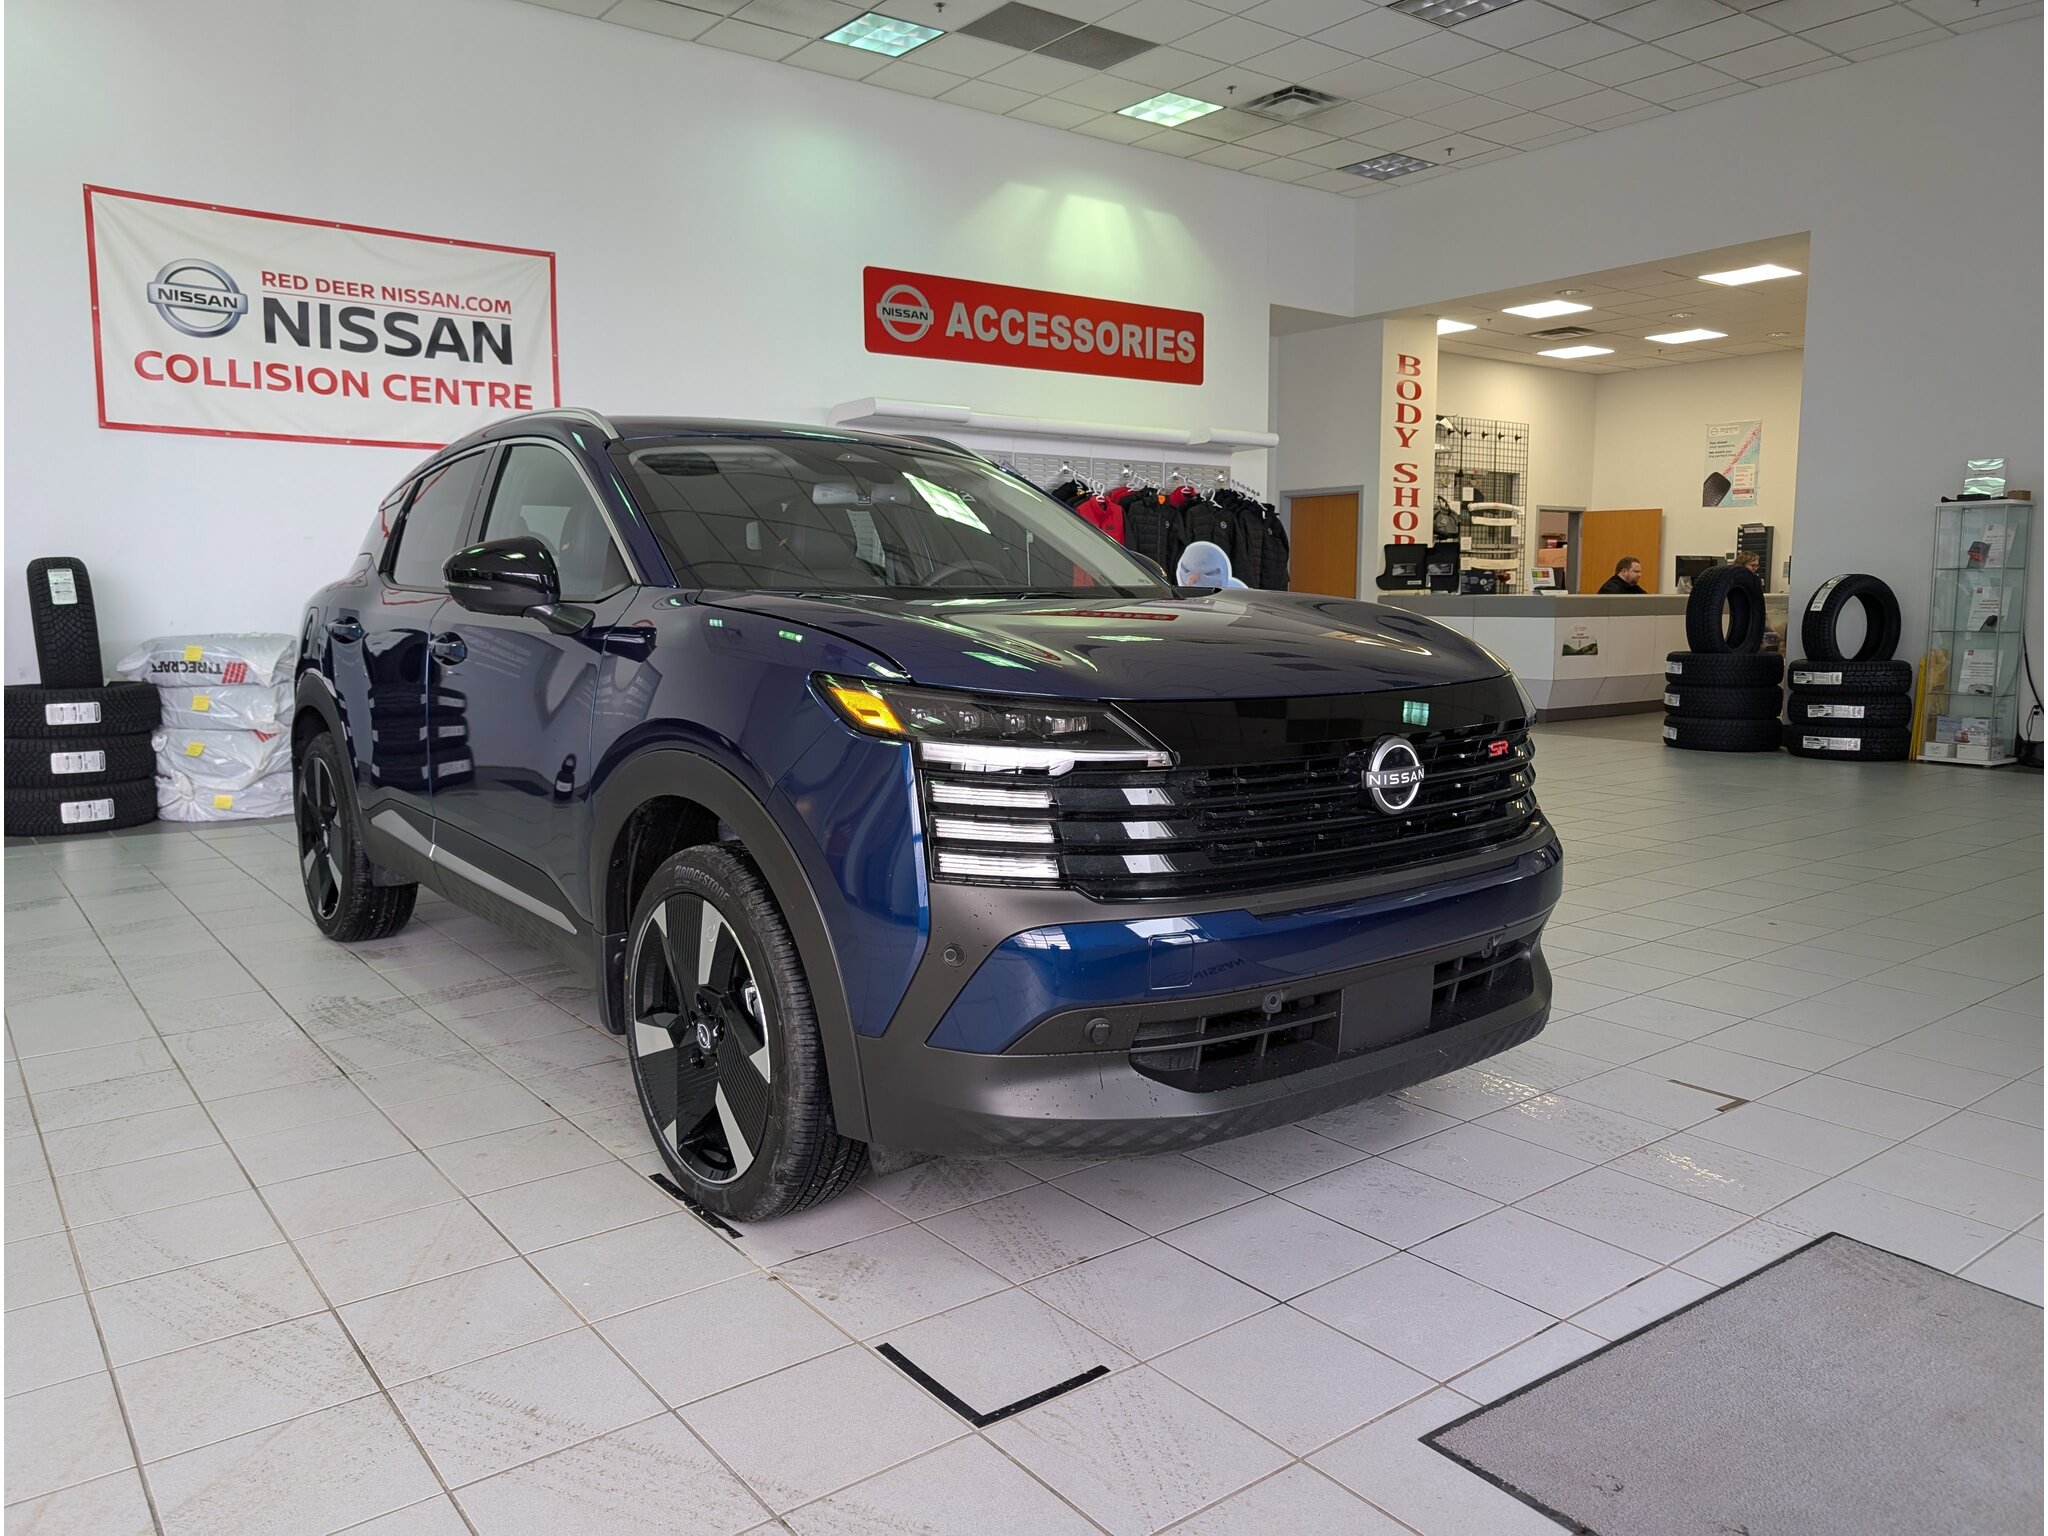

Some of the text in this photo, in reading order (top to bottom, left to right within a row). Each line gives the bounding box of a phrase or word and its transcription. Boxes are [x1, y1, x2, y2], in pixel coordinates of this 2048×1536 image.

[157, 287, 238, 309] NISSAN
[262, 271, 512, 314] RED DEER NISSAN.COM
[882, 306, 929, 321] NISSAN
[263, 297, 513, 365] NISSAN
[945, 301, 1196, 364] ACCESSORIES
[134, 350, 533, 410] COLLISION CENTRE
[1393, 353, 1422, 449] BODY
[1488, 739, 1510, 758] SR
[1368, 767, 1425, 786] NISSAN
